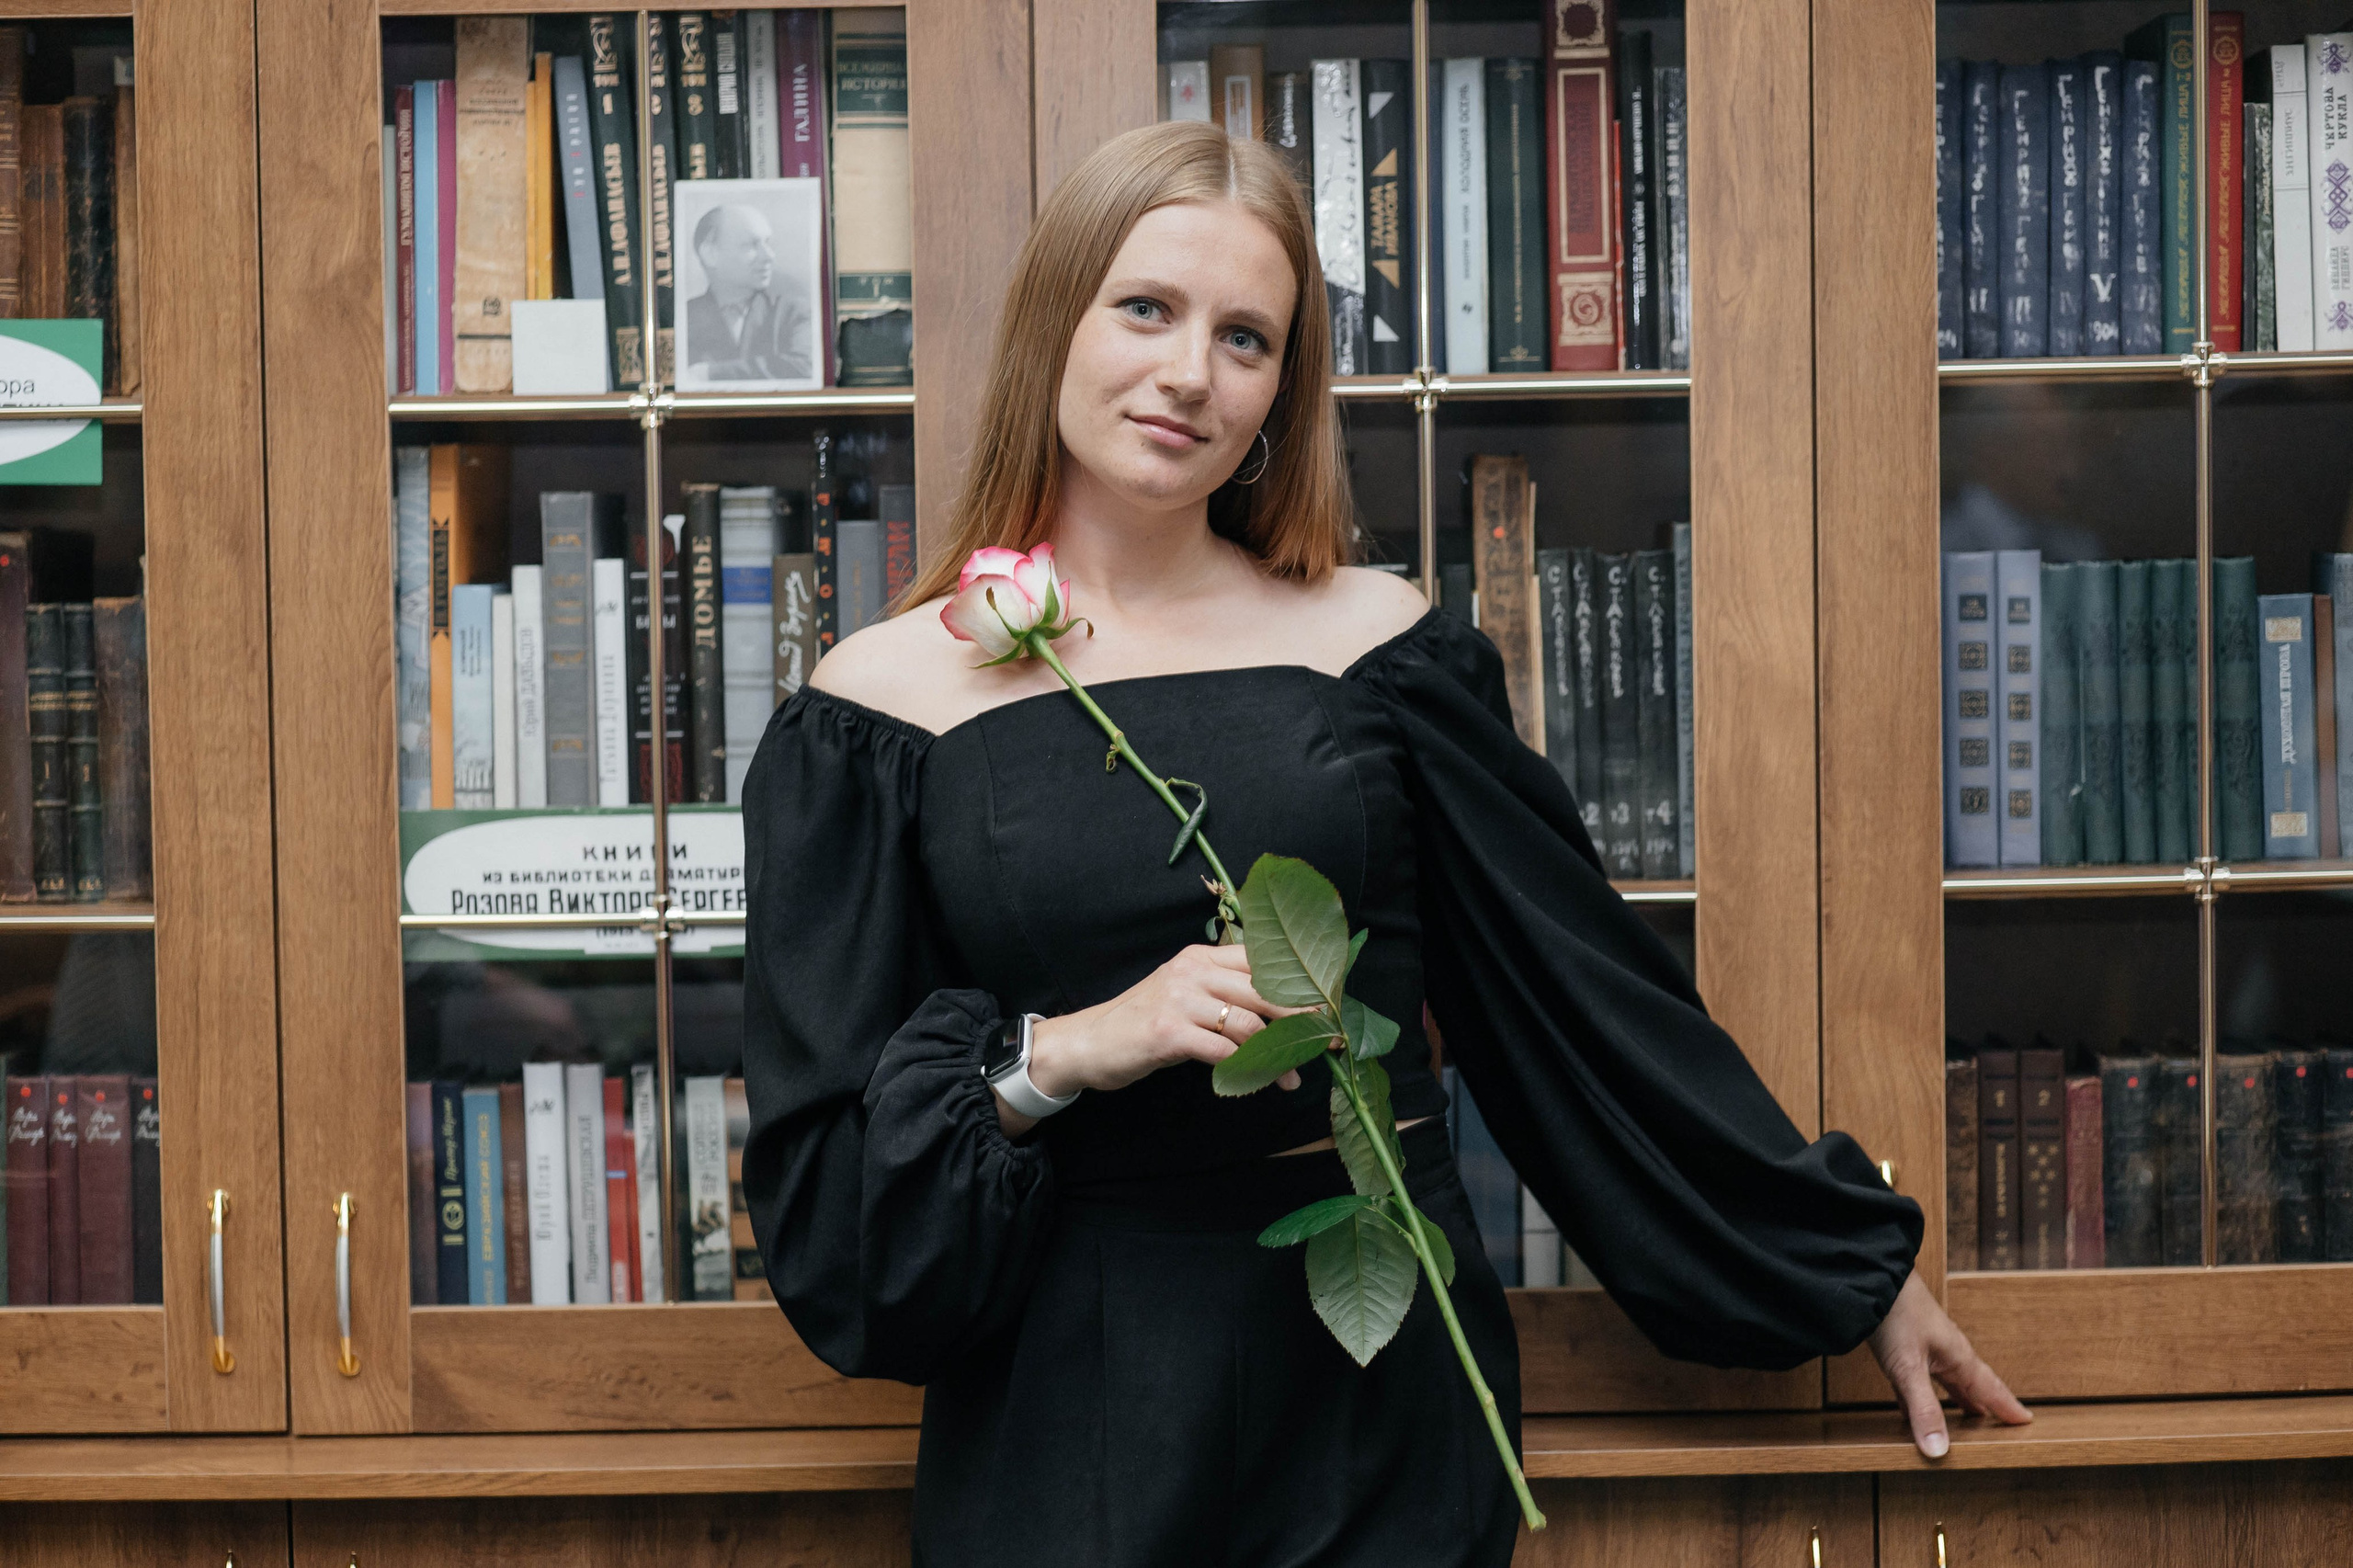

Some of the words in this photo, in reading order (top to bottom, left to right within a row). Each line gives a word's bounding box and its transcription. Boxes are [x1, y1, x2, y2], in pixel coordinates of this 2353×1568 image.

[794, 63, 810, 143] ГАЛИНА
[2338, 95, 2348, 139] КУКЛА
[1370, 185, 1384, 249] ТАМАРА
[691, 535, 718, 650] ДОМЬЕ
[483, 871, 502, 883] ИЗ
[510, 869, 632, 884] БИБЛИОТЕКИ
[640, 867, 741, 882] ДАМАТУР
[584, 844, 688, 861] КНИИ
